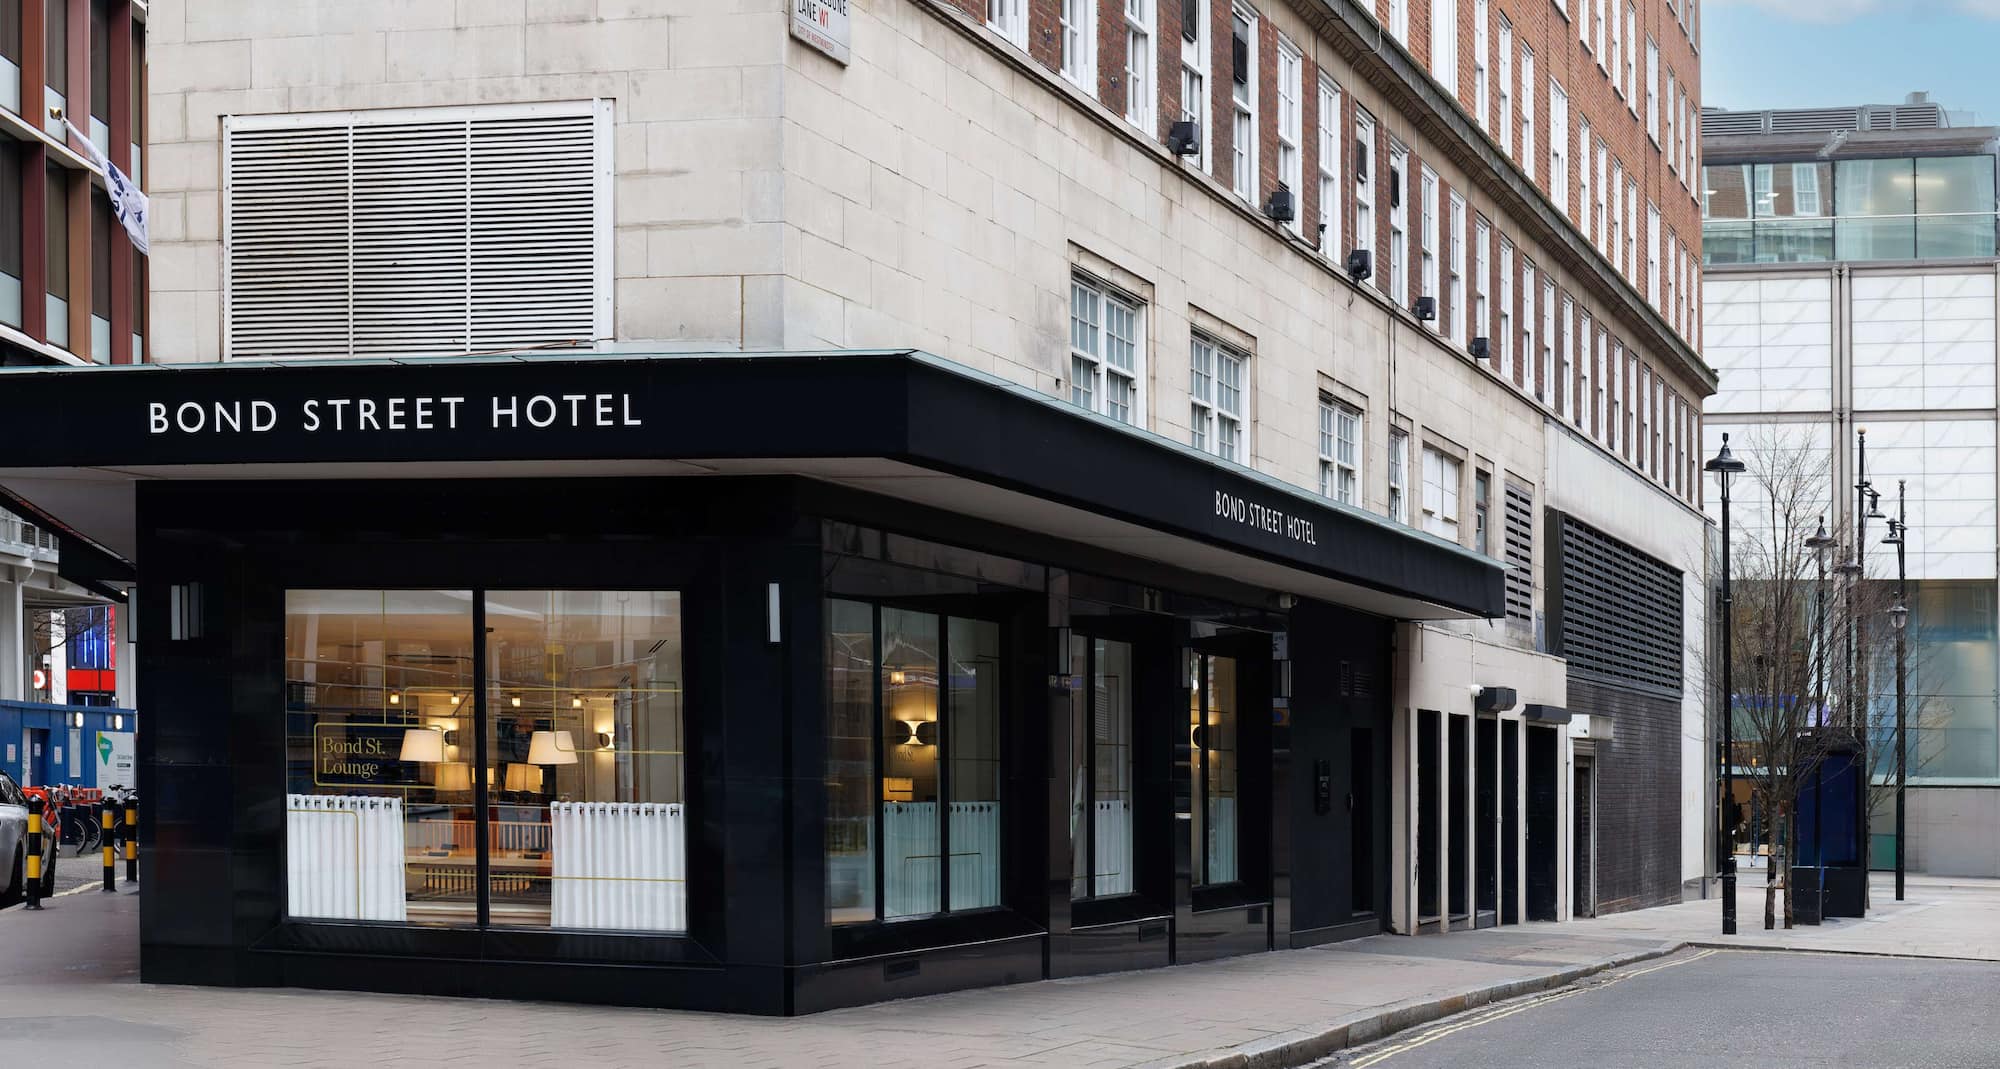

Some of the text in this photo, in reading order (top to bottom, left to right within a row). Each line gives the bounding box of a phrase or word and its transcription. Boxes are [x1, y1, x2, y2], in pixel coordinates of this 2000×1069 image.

[798, 0, 829, 29] LANE W1
[150, 394, 642, 433] BOND STREET HOTEL
[1215, 490, 1317, 545] BOND STREET HOTEL
[322, 736, 386, 754] Bond St.
[322, 758, 379, 779] Lounge
